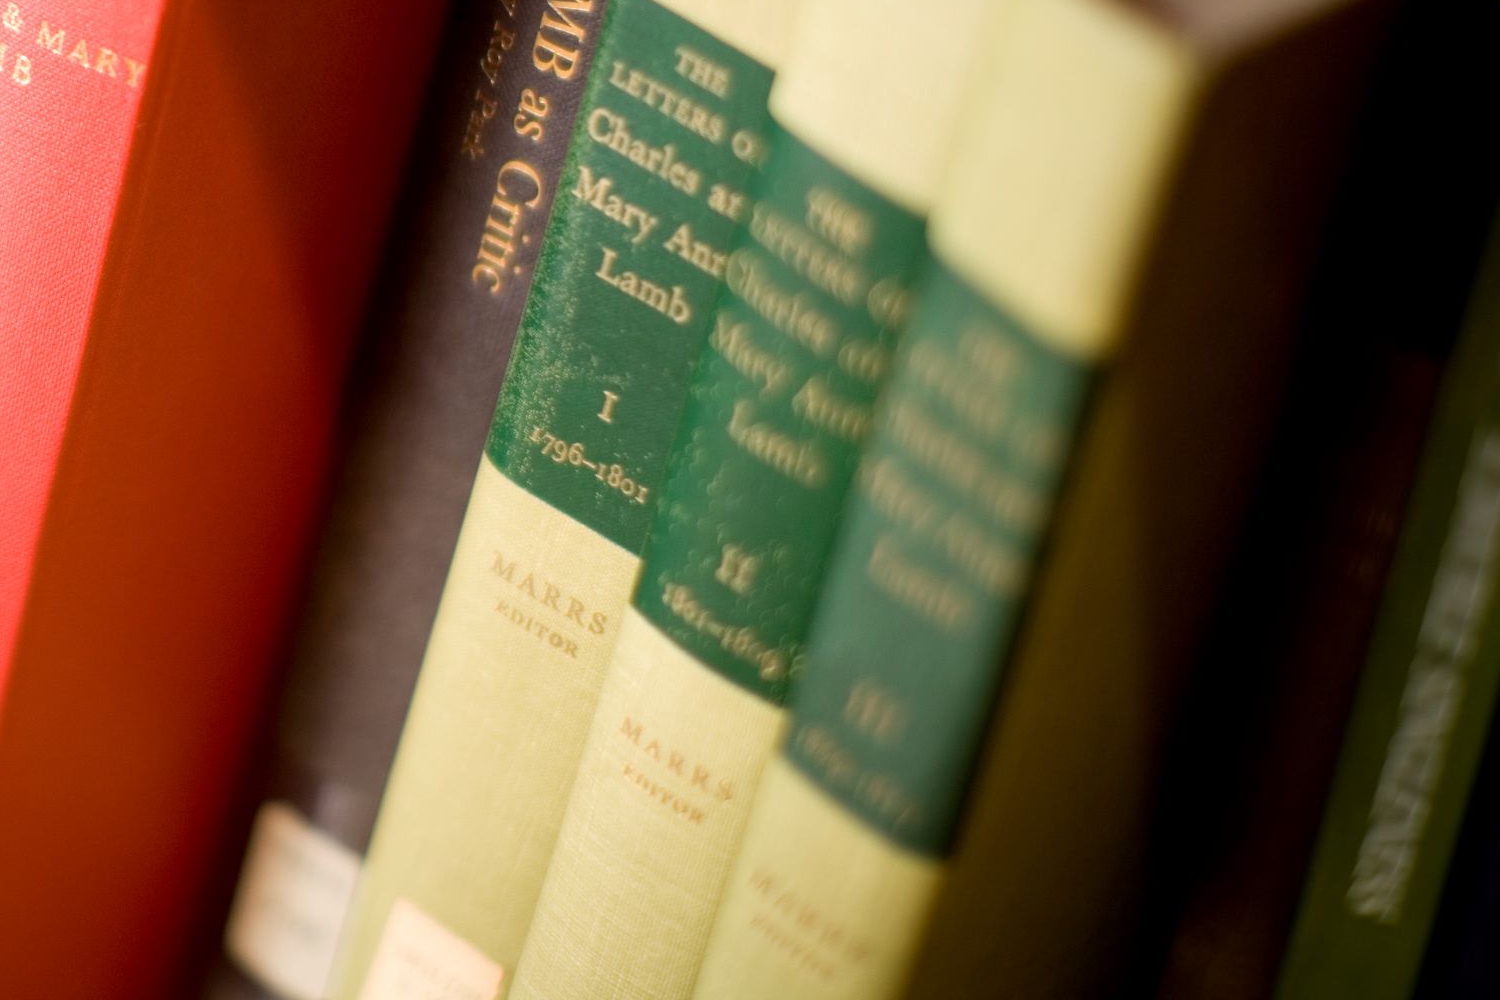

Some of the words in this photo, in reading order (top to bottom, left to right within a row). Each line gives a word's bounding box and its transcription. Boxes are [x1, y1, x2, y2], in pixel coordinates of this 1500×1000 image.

[2, 2, 25, 34] &
[37, 20, 147, 88] MARY
[479, 19, 516, 86] Roy
[673, 47, 733, 100] THE
[513, 87, 549, 143] as
[607, 60, 726, 145] LETTERS
[587, 106, 702, 199] Charles
[471, 159, 543, 296] Critic
[571, 164, 659, 243] Mary
[595, 247, 693, 326] Lamb
[491, 551, 610, 636] MARRS
[495, 599, 580, 660] EDITOR
[620, 716, 734, 802] MARRS
